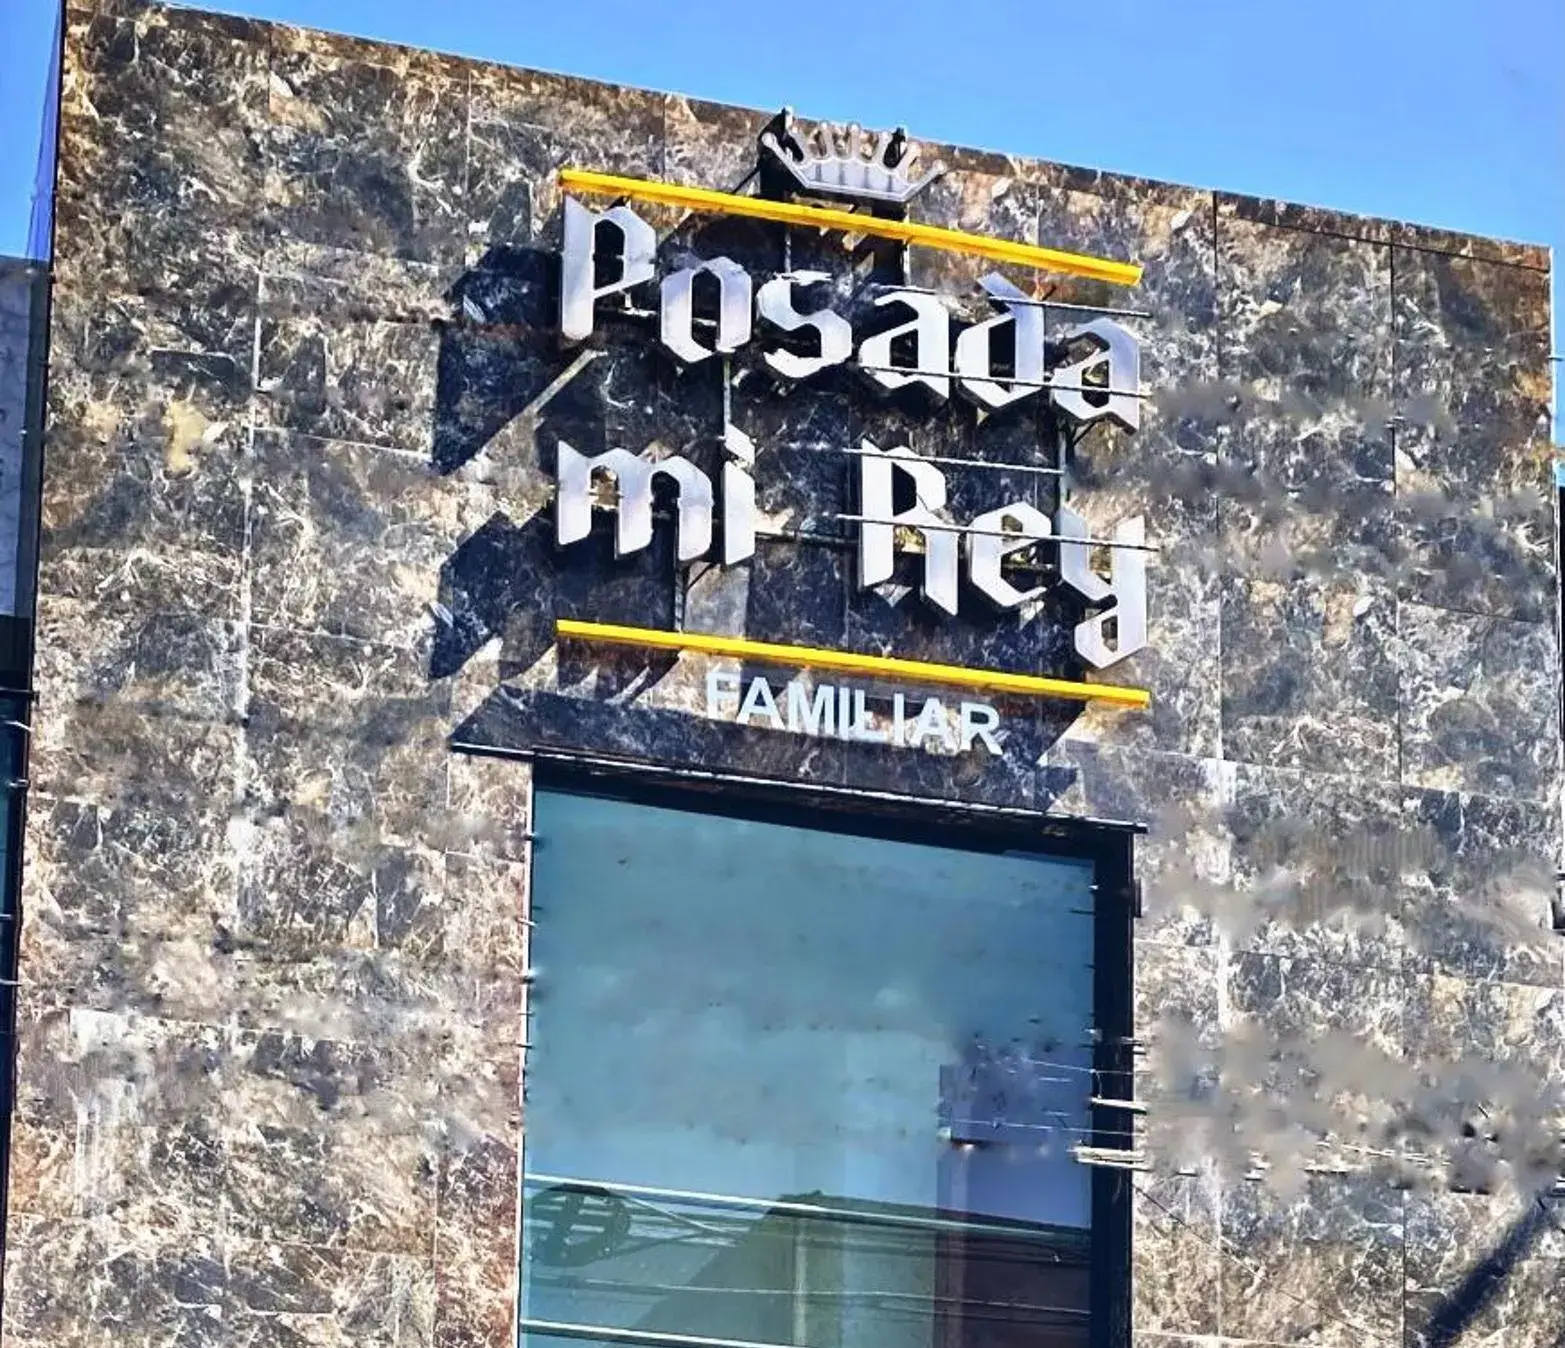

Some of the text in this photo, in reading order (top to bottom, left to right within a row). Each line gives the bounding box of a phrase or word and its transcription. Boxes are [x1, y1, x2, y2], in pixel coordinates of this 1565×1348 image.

[562, 196, 1142, 433] Posada
[861, 437, 1148, 670] Rey
[705, 671, 1003, 756] FAMILIAR
